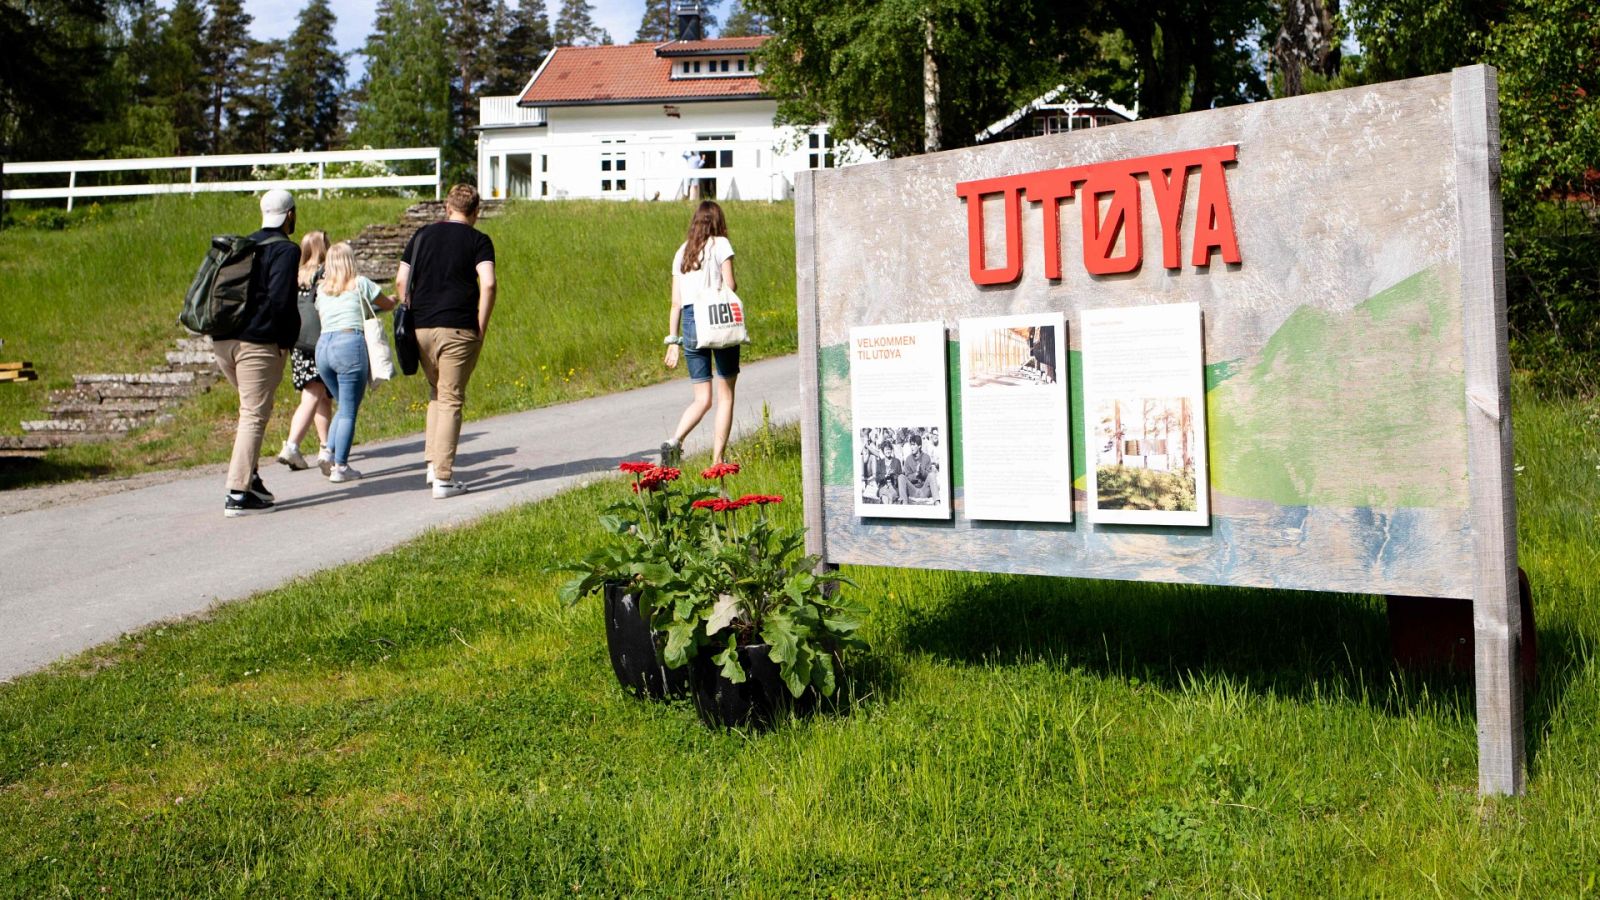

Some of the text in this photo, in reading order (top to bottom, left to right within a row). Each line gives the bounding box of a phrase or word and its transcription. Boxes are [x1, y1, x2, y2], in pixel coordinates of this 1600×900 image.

[956, 145, 1242, 285] UTØYA
[857, 336, 916, 348] VELKOMMEN
[857, 349, 902, 360] TIL UTØYA
